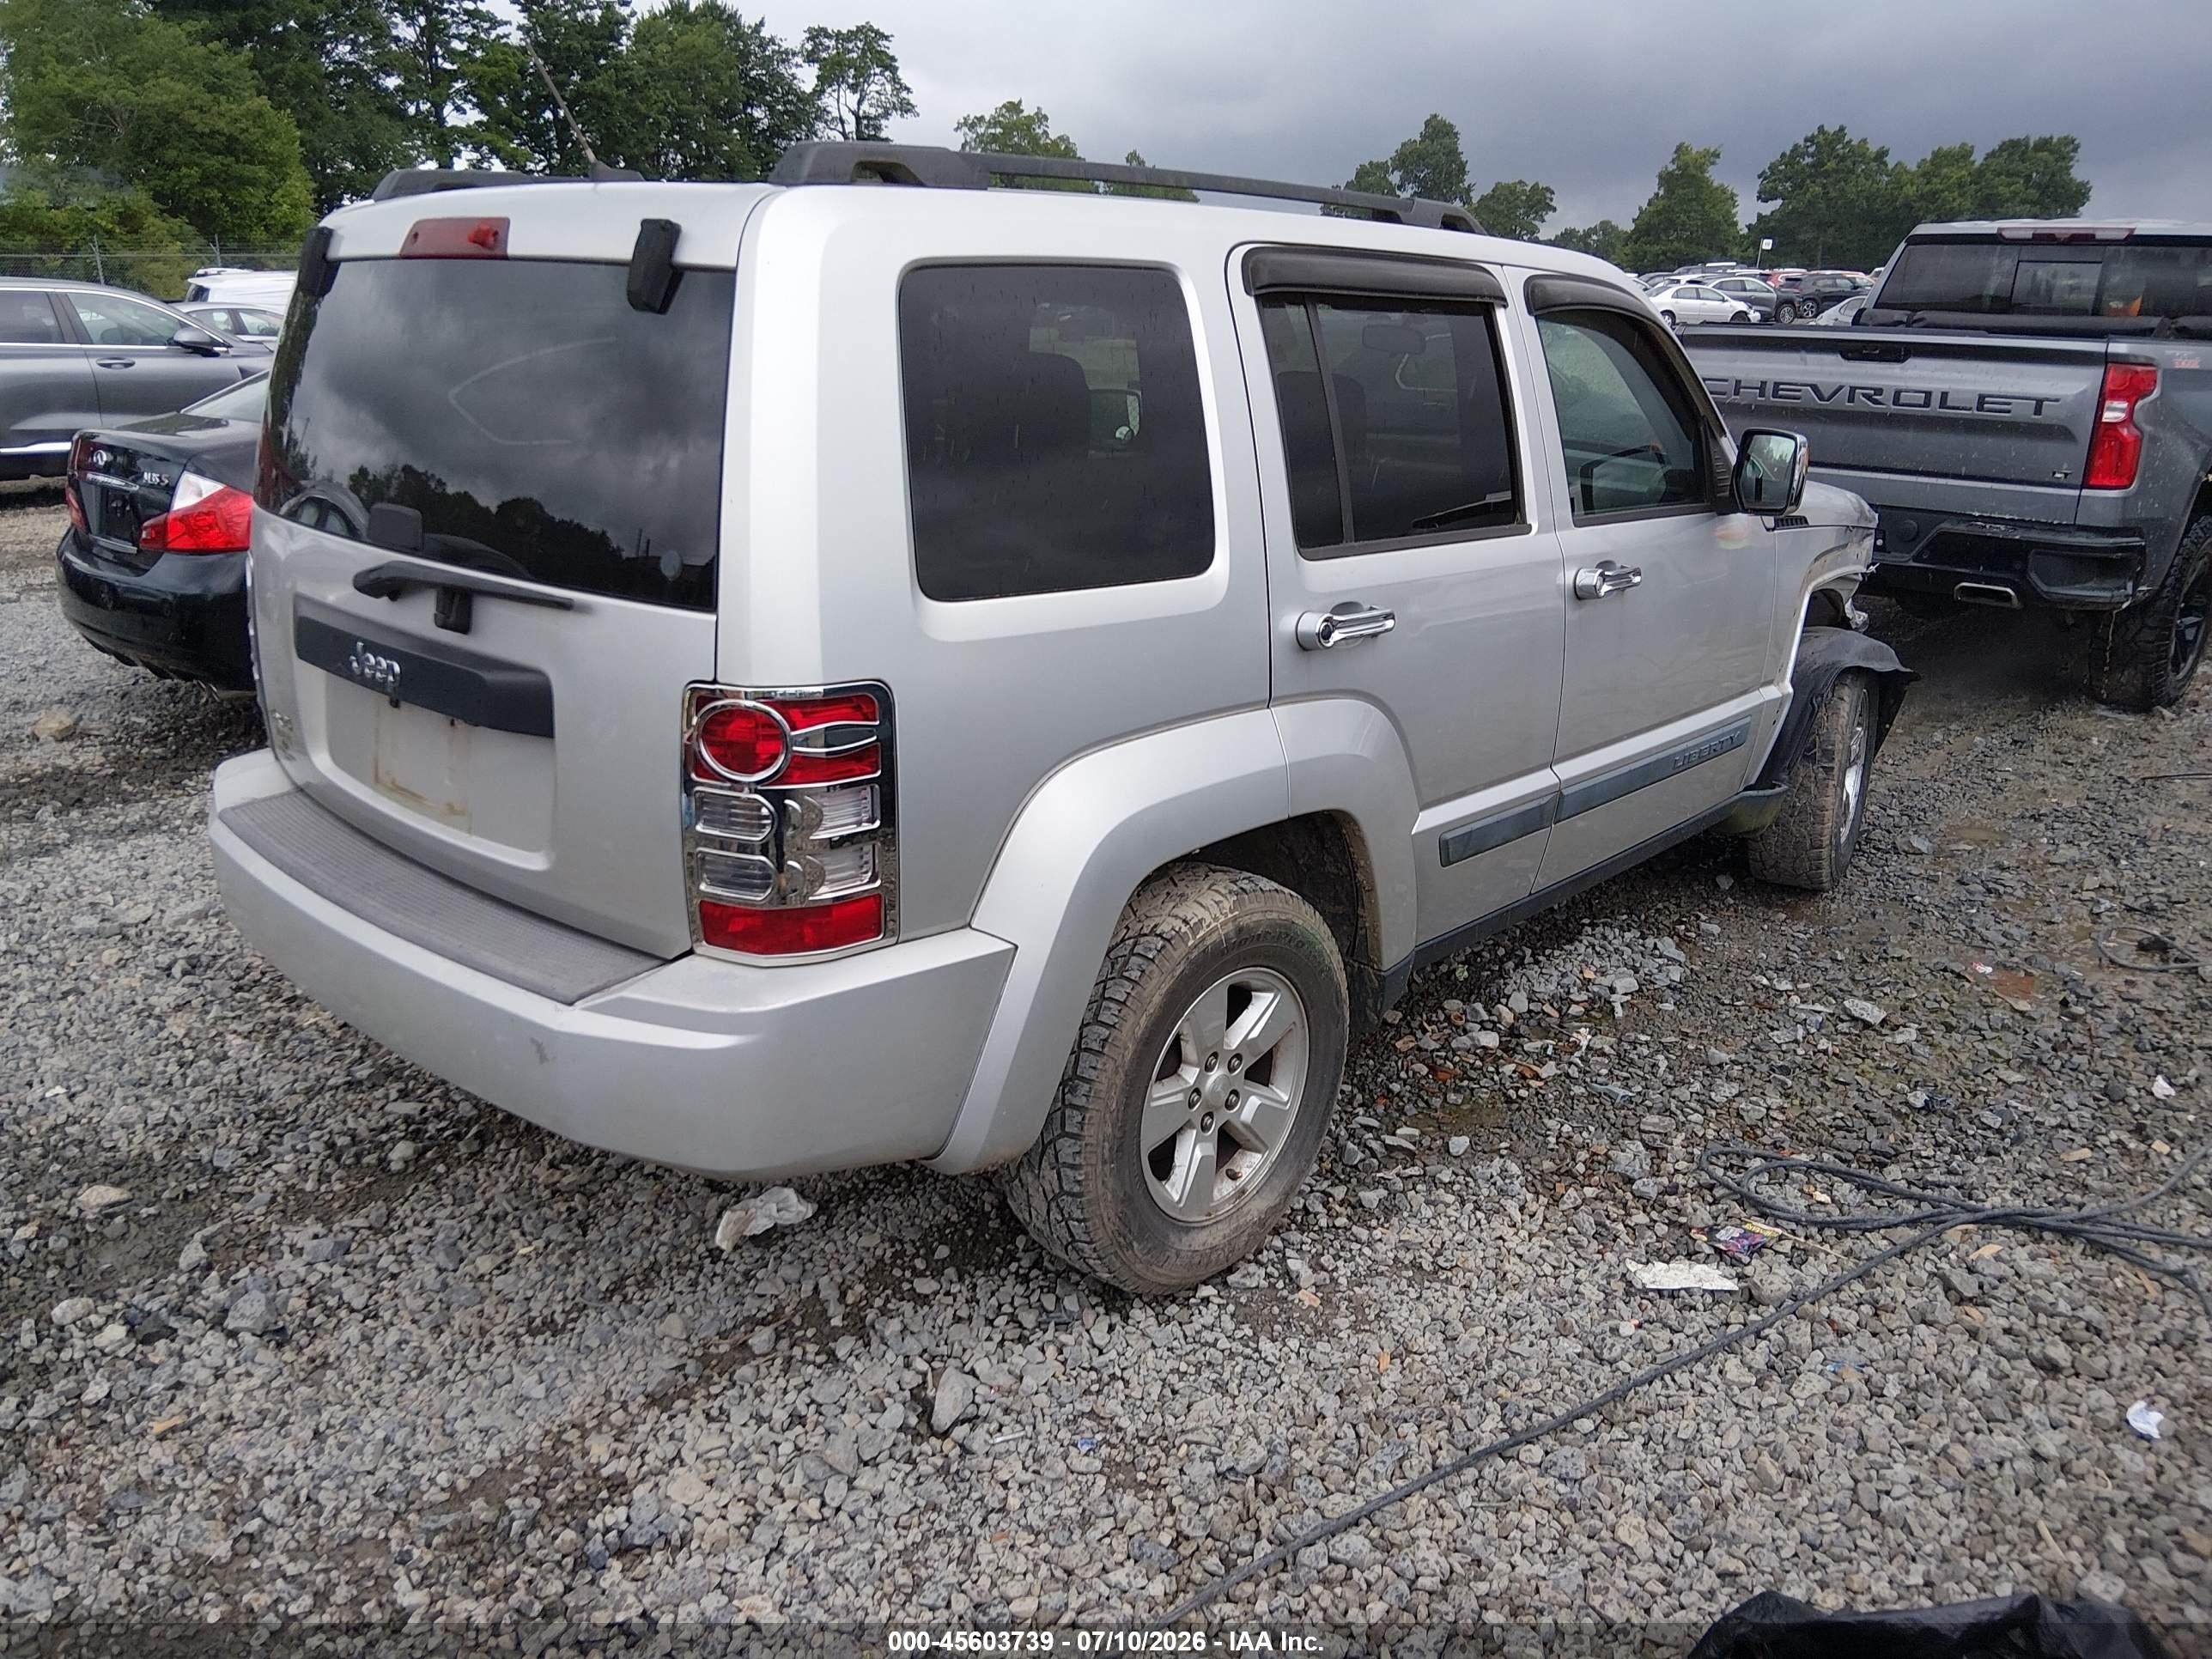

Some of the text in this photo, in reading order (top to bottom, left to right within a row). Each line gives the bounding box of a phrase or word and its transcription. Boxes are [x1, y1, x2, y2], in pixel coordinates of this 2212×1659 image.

[1702, 376, 2061, 418] CHEVROLET
[349, 641, 400, 692] Jeep
[1673, 731, 1741, 770] LIBERTY
